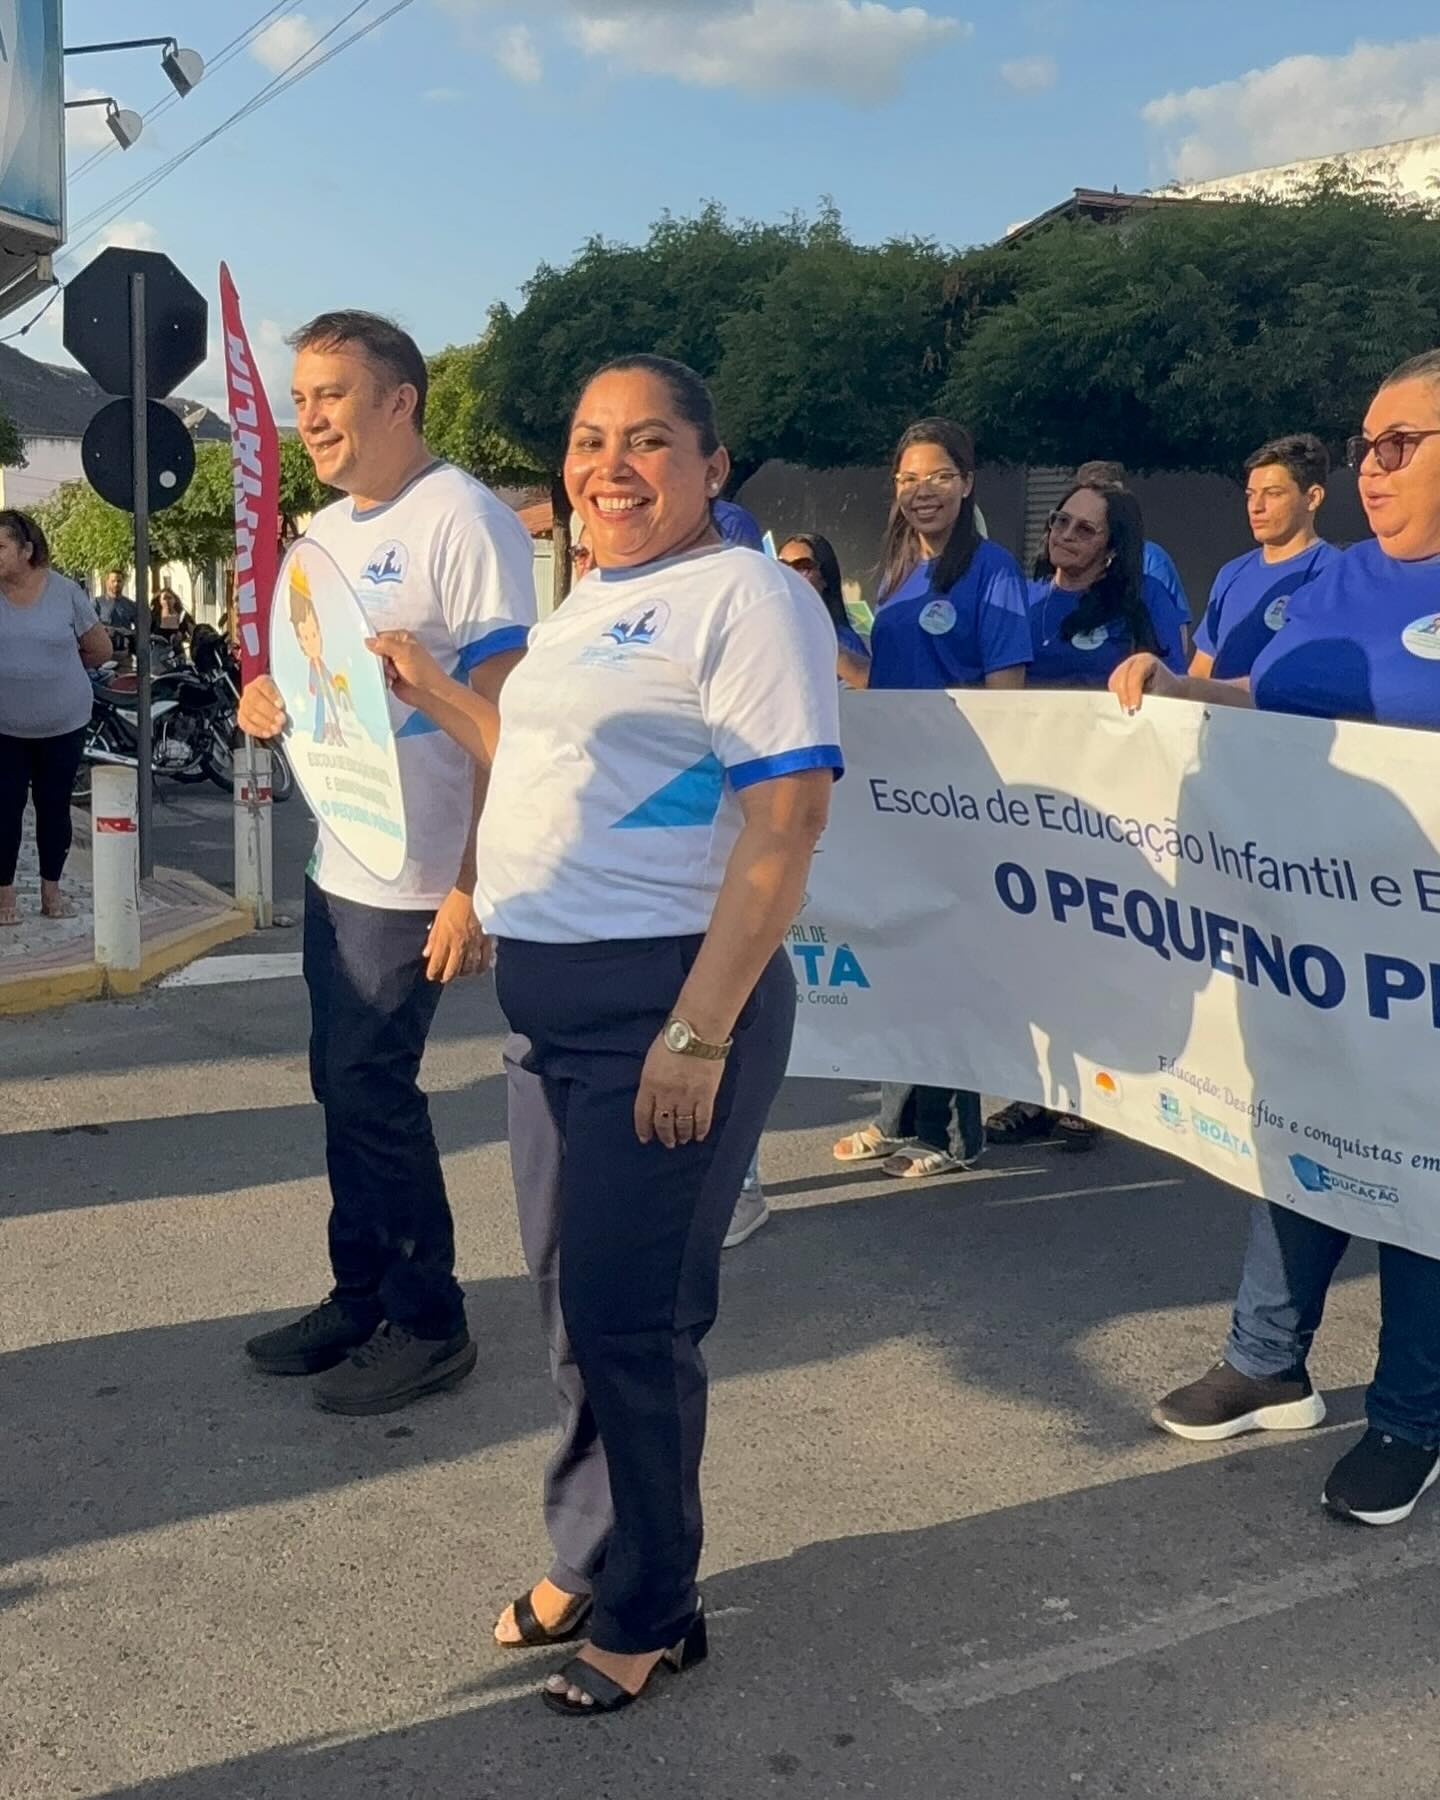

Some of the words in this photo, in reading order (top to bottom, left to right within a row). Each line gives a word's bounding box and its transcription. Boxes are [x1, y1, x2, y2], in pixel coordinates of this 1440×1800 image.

[869, 778, 979, 821] Escola
[986, 789, 1030, 827] de
[1035, 793, 1204, 864] Educação
[1208, 831, 1358, 902] Infantil
[1371, 875, 1402, 908] e
[809, 925, 829, 944] DE
[994, 862, 1037, 915] O
[1045, 868, 1347, 1010] PEQUENO
[1364, 952, 1440, 1030] P
[1224, 1084, 1284, 1129] Desafios
[1289, 1120, 1299, 1134] e
[1303, 1125, 1403, 1165] conquistas
[1316, 1163, 1400, 1204] EDUCAÇÃO
